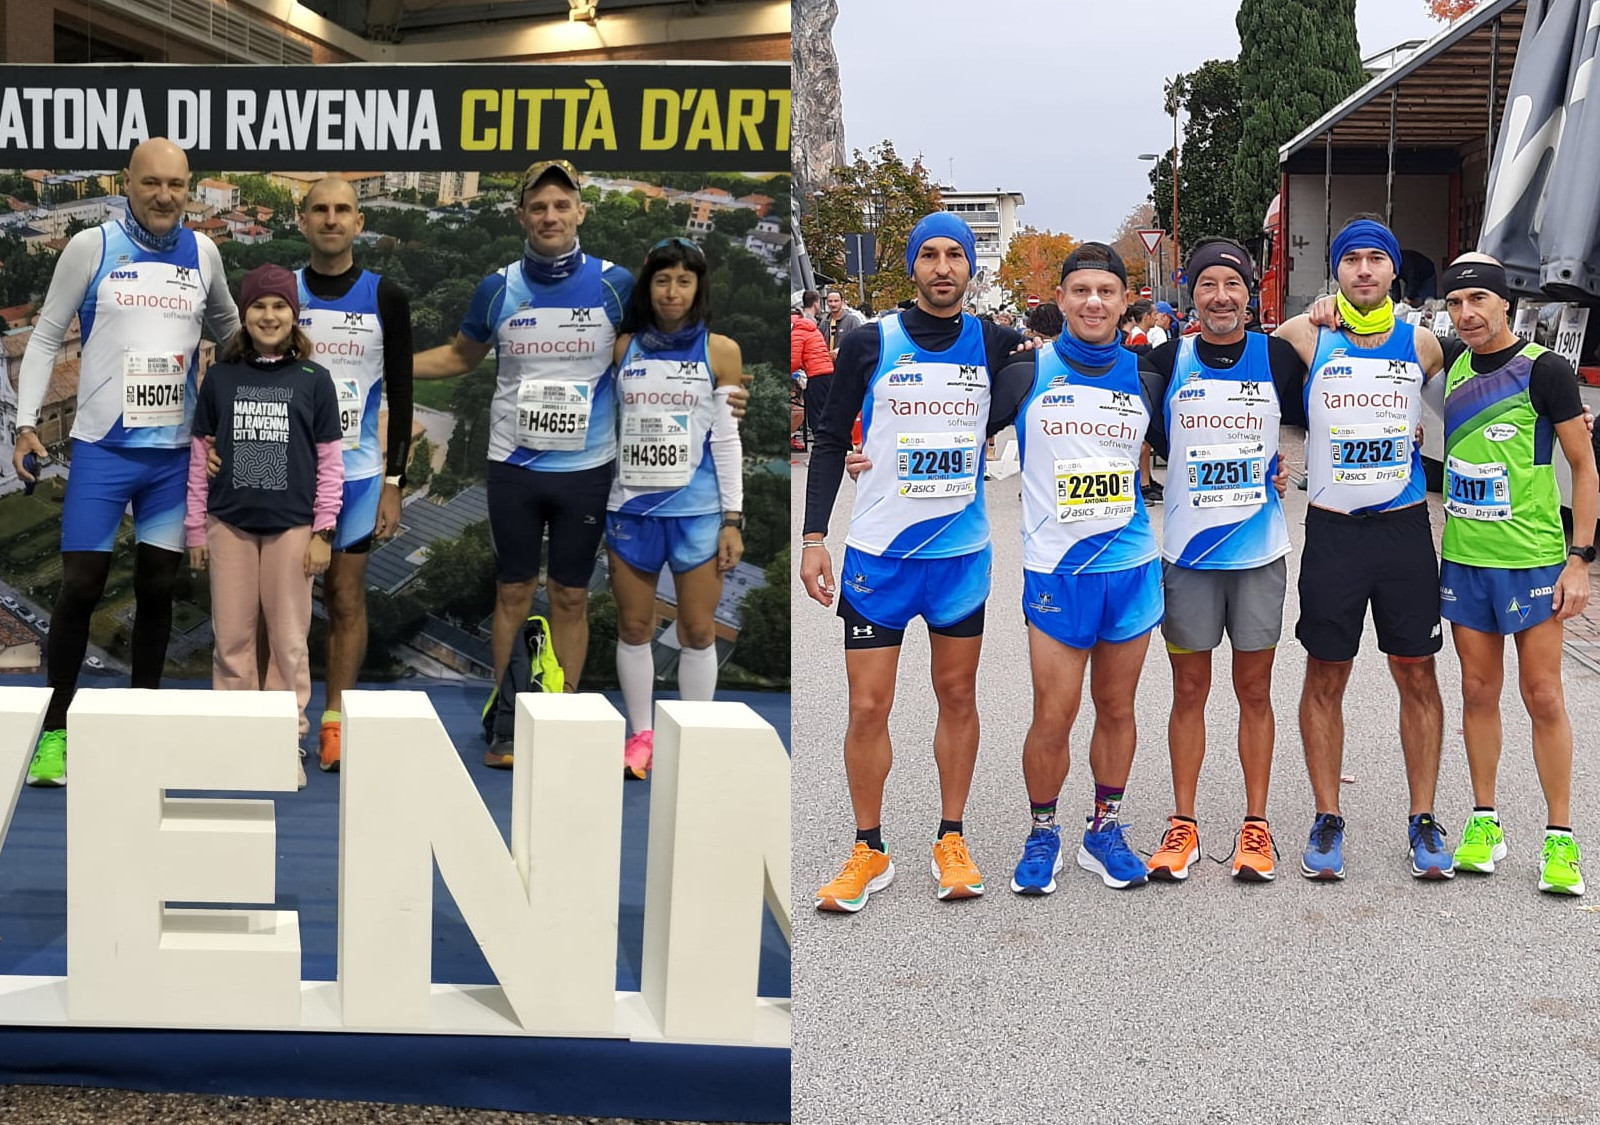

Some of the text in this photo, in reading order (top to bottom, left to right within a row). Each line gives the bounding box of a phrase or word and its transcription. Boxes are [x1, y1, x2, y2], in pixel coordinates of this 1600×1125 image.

[0, 78, 791, 151] ATONA DI RAVENNA CITTÀ D'ART
[109, 270, 139, 280] AVIS
[114, 291, 193, 312] Ranocchi
[297, 317, 313, 326] VIS
[509, 317, 537, 327] AVIS
[315, 340, 365, 357] occhi
[508, 338, 596, 355] Ranocchi
[1557, 331, 1582, 354] 1901
[623, 368, 647, 377] AVIS
[889, 373, 923, 383] AVIS
[1323, 366, 1353, 376] AVIS
[136, 384, 179, 407] H5074
[1042, 395, 1075, 404] AVIS
[1179, 388, 1206, 398] AVIS
[1322, 391, 1408, 409] Ranocchi
[233, 401, 288, 416] MARATONA
[888, 398, 980, 417] Ranocchi
[1375, 410, 1408, 420] software
[233, 415, 290, 431] DI RAVENNA
[528, 411, 576, 433] H4655
[1179, 412, 1264, 430] Ranocchi
[259, 429, 290, 443] D'ARTE
[1040, 419, 1137, 441] Ranocchi
[1227, 432, 1261, 442] software
[1099, 439, 1134, 451] software
[1343, 440, 1393, 464] 2252
[631, 444, 677, 467] H4368
[912, 450, 963, 475] 2249
[1201, 461, 1249, 485] 2251
[1344, 472, 1367, 481] asics
[912, 484, 936, 493] asics
[1069, 473, 1120, 499] 2250
[1454, 475, 1486, 501] 2117
[1202, 494, 1224, 503] asics
[1233, 492, 1257, 503] Drya
[1071, 507, 1095, 517] asics
[1450, 504, 1468, 515] sics
